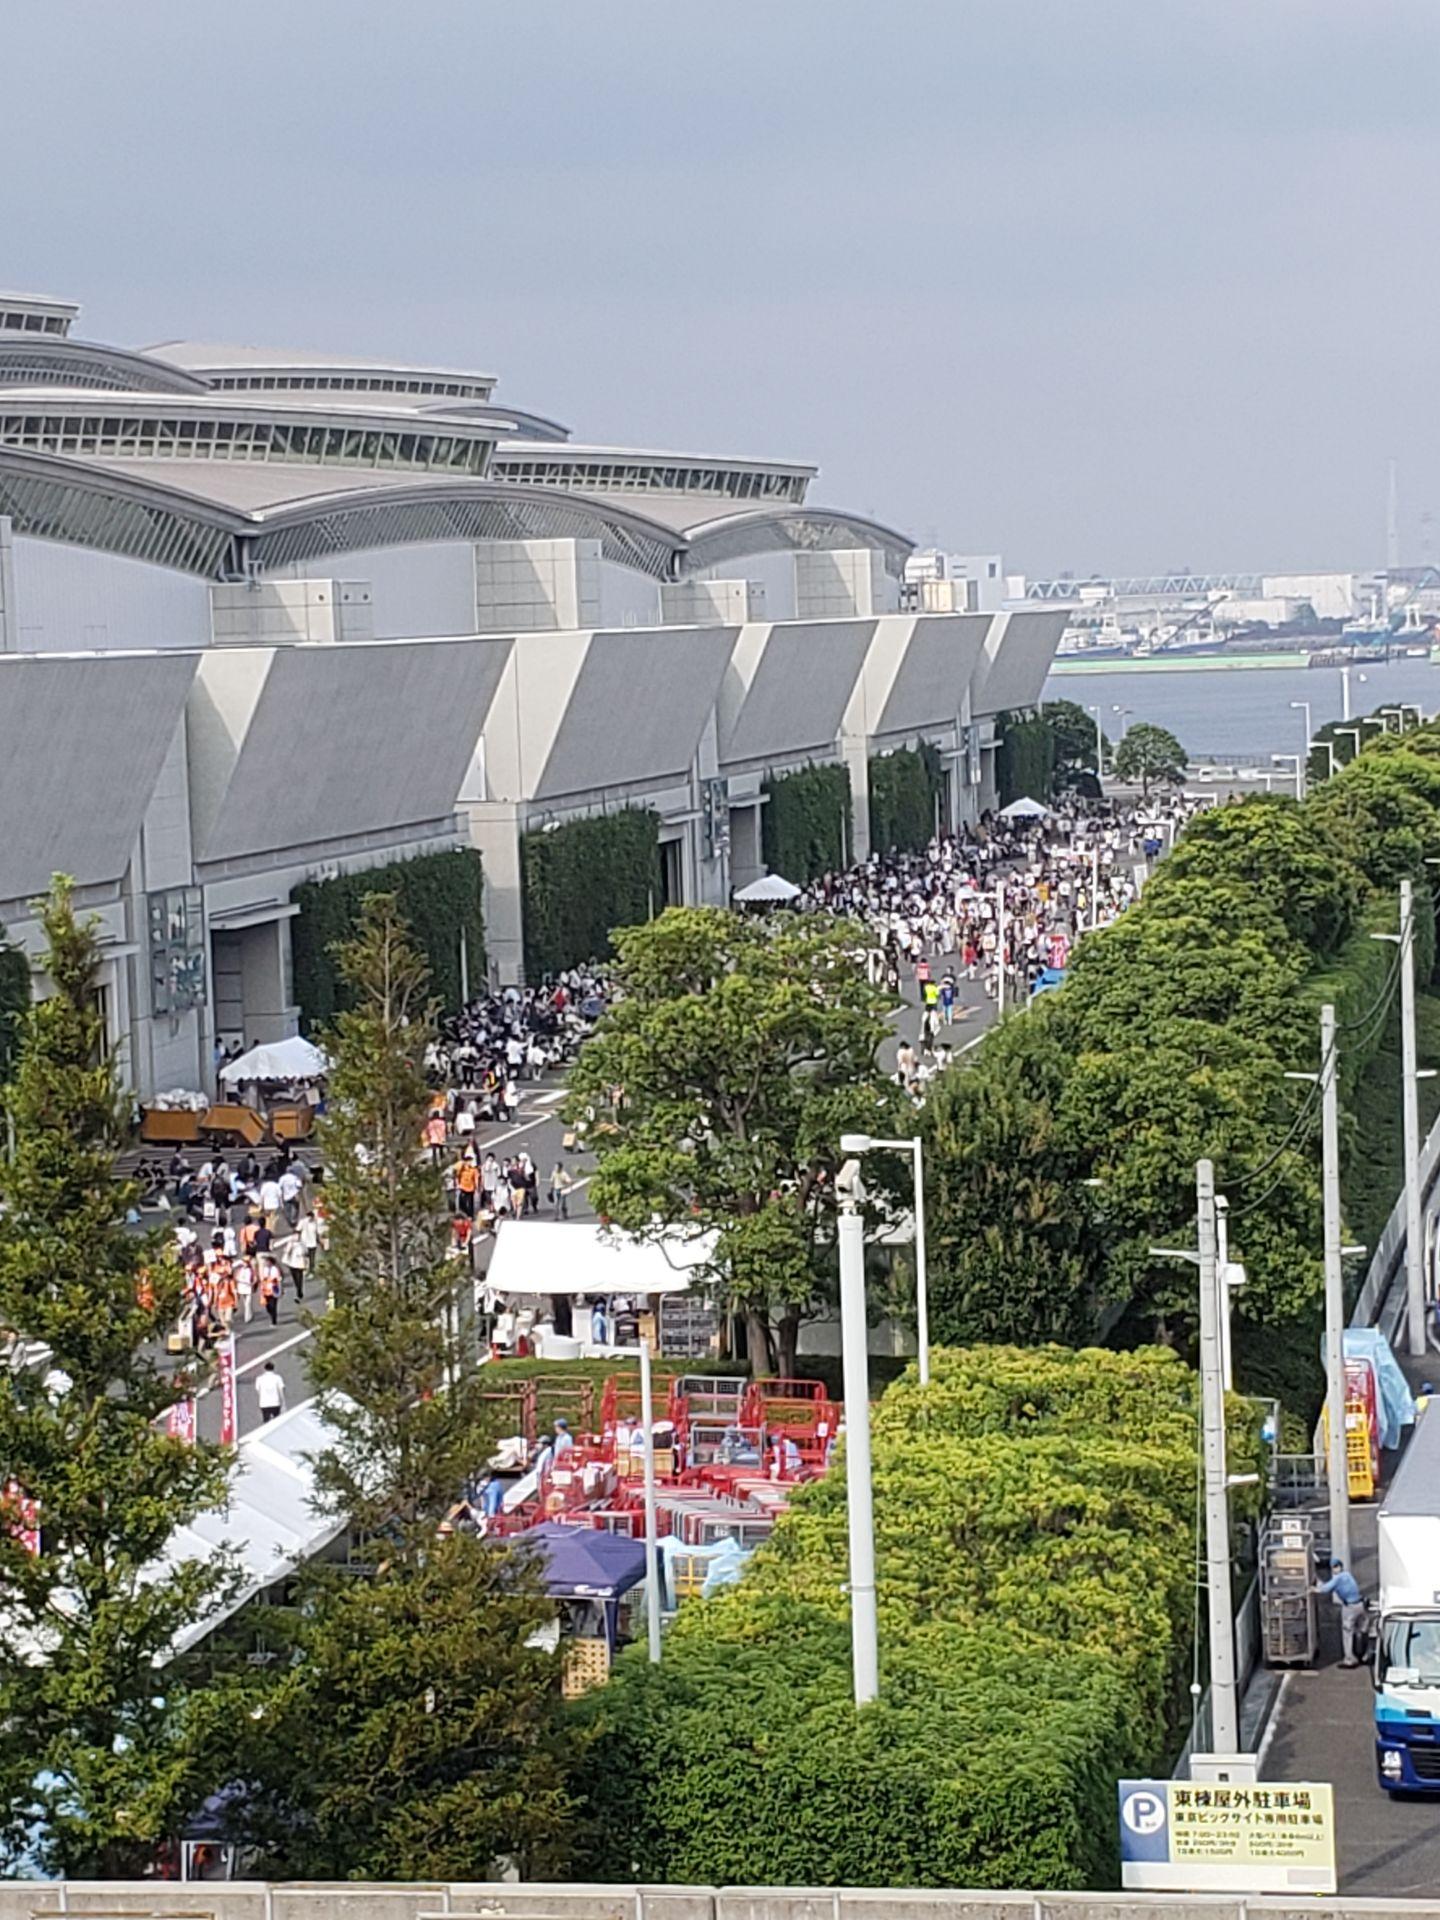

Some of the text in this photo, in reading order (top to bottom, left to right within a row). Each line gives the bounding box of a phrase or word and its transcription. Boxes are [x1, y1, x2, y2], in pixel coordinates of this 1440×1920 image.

[1174, 1789, 1311, 1810] 東棟屋外駐車場
[1133, 1798, 1157, 1828] P
[1175, 1812, 1324, 1825] 東京ビッグサイト専用駐車場
